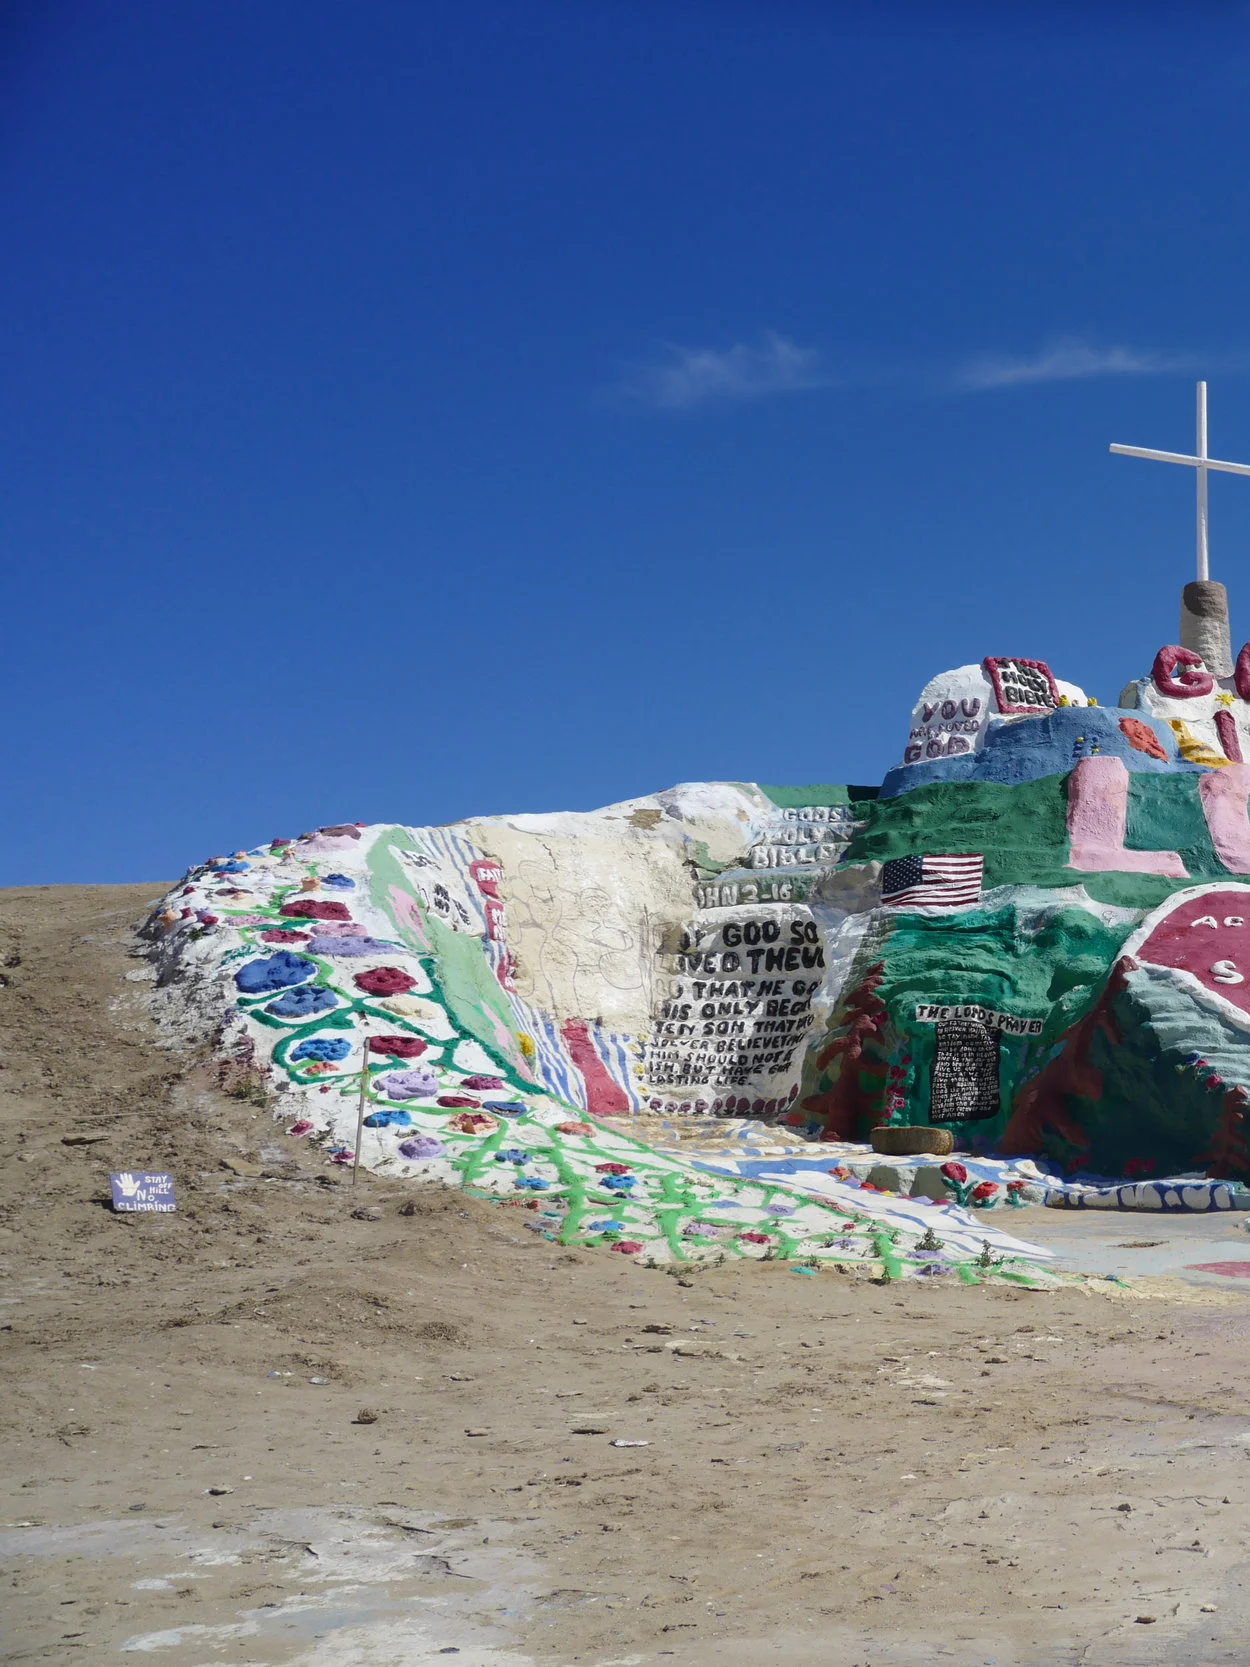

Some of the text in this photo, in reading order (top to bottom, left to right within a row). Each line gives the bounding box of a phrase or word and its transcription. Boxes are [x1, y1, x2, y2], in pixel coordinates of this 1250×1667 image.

[1002, 670, 1049, 694] HOLY
[1005, 686, 1056, 708] BIBLE
[922, 697, 981, 722] YOU
[904, 736, 971, 765] GOD
[722, 920, 780, 948] GOD
[790, 920, 820, 946] SO
[747, 947, 801, 975] THE
[692, 979, 756, 999] THAT
[701, 1000, 760, 1018] ONLY
[918, 1005, 949, 1019] THE
[954, 1006, 995, 1025] LORDS
[998, 1015, 1042, 1034] PRAYER
[655, 1021, 695, 1035] TEN
[703, 1021, 745, 1035] SON
[753, 1020, 797, 1033] THAT
[650, 1050, 680, 1060] HIM
[684, 1052, 748, 1066] SHOULD
[752, 1050, 784, 1065] NOT
[650, 1074, 709, 1085] LASTING
[683, 1063, 716, 1075] BUT
[144, 1175, 168, 1183] STAY
